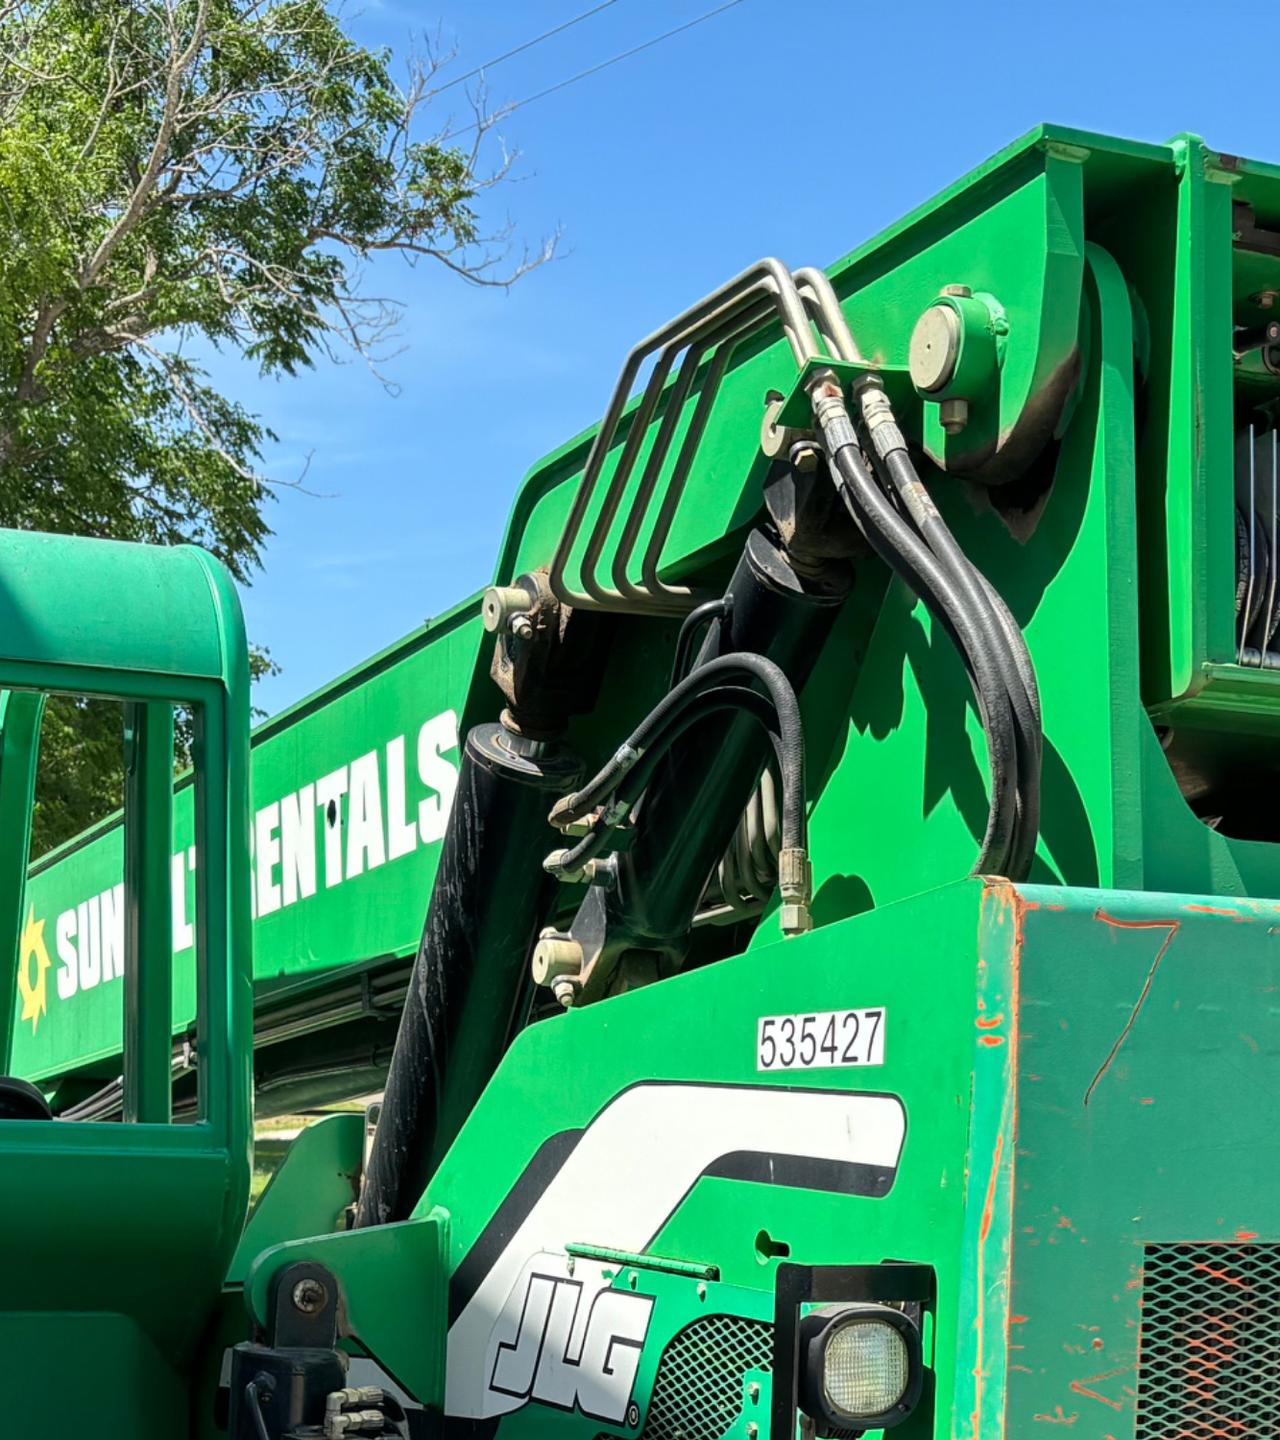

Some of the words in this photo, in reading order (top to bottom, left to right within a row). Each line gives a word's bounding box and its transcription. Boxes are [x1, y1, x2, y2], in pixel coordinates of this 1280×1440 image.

[250, 709, 460, 921] ENTALS
[760, 1010, 883, 1068] 535427
[488, 1271, 657, 1428] JLG
